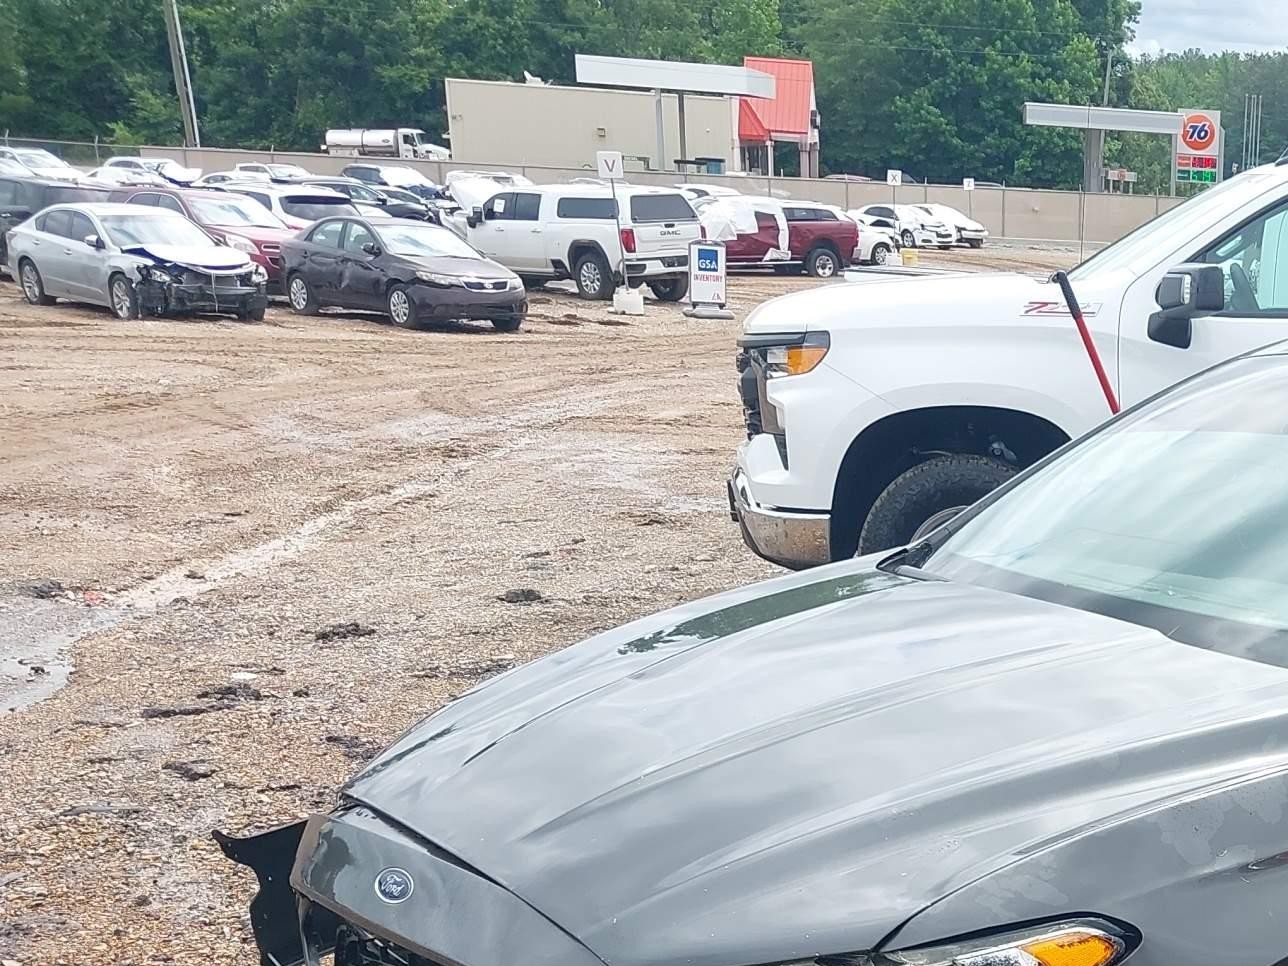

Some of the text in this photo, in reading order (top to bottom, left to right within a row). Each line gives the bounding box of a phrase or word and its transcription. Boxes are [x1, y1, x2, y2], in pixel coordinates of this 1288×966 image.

[1187, 123, 1210, 141] 76
[604, 160, 616, 172] V
[890, 173, 899, 183] X
[698, 259, 718, 270] GSA
[694, 273, 723, 283] INVENTORY
[381, 874, 405, 896] Ford
